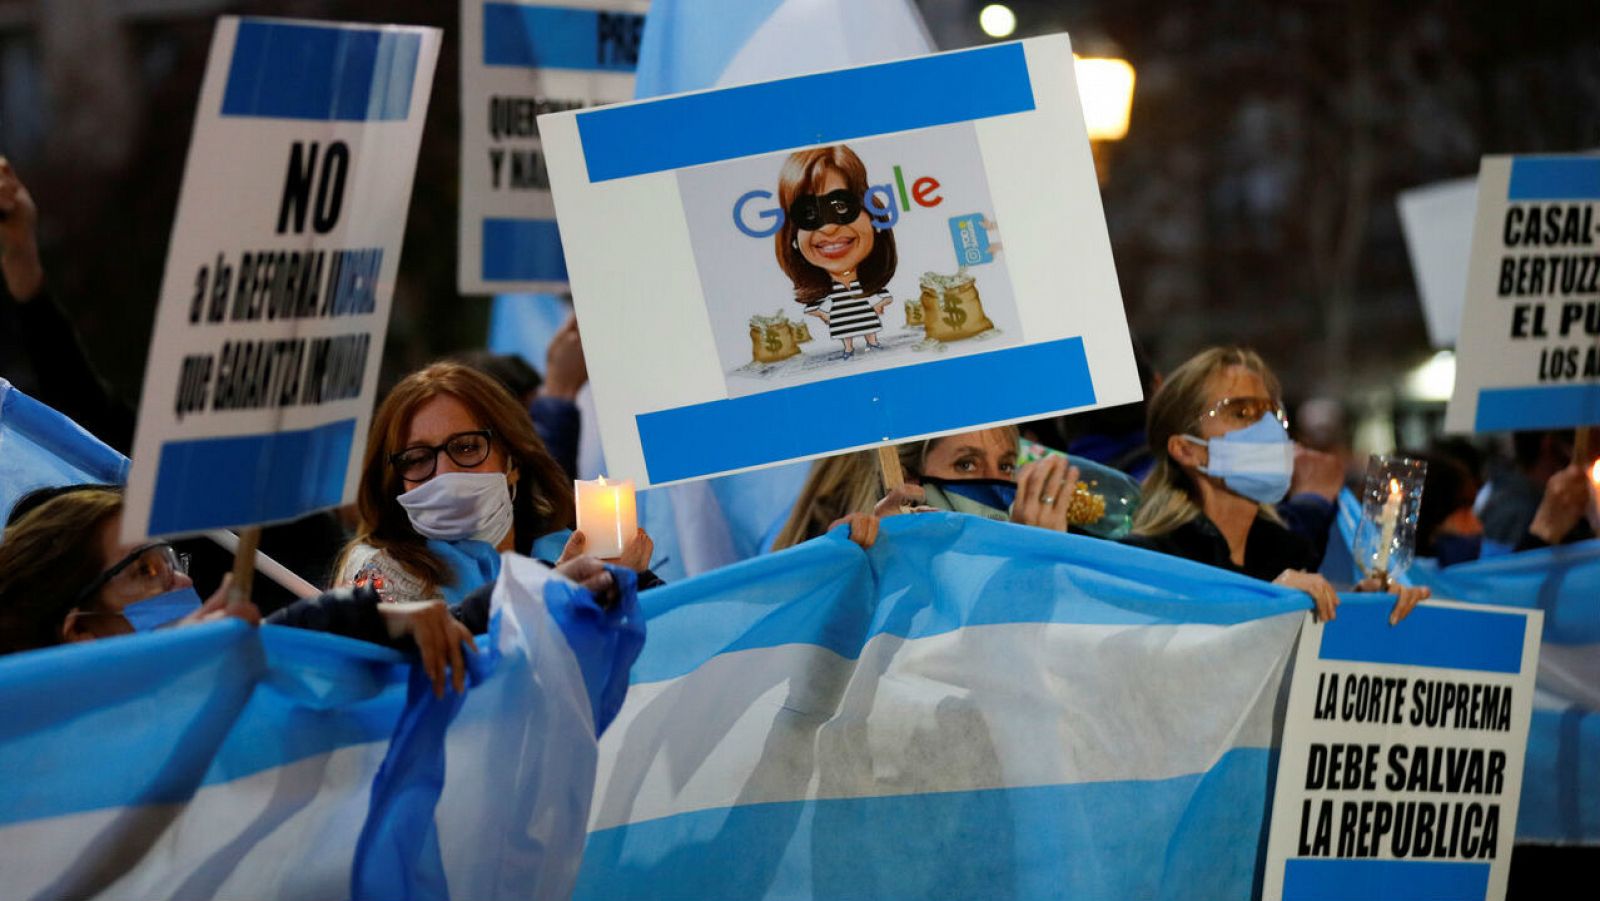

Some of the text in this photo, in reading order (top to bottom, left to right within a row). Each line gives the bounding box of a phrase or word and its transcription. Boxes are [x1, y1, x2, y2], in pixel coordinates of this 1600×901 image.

[276, 141, 349, 235] NO
[489, 149, 504, 190] Y
[732, 164, 944, 238] Ggle
[189, 264, 208, 324] a
[206, 251, 232, 323] la
[1511, 302, 1548, 339] EL
[1539, 344, 1600, 383] LOS A
[1313, 672, 1513, 732] LA CORTE SUPREMA
[1304, 743, 1507, 795] DEBE SALVAR
[1297, 799, 1501, 859] LA REPUBLICA
